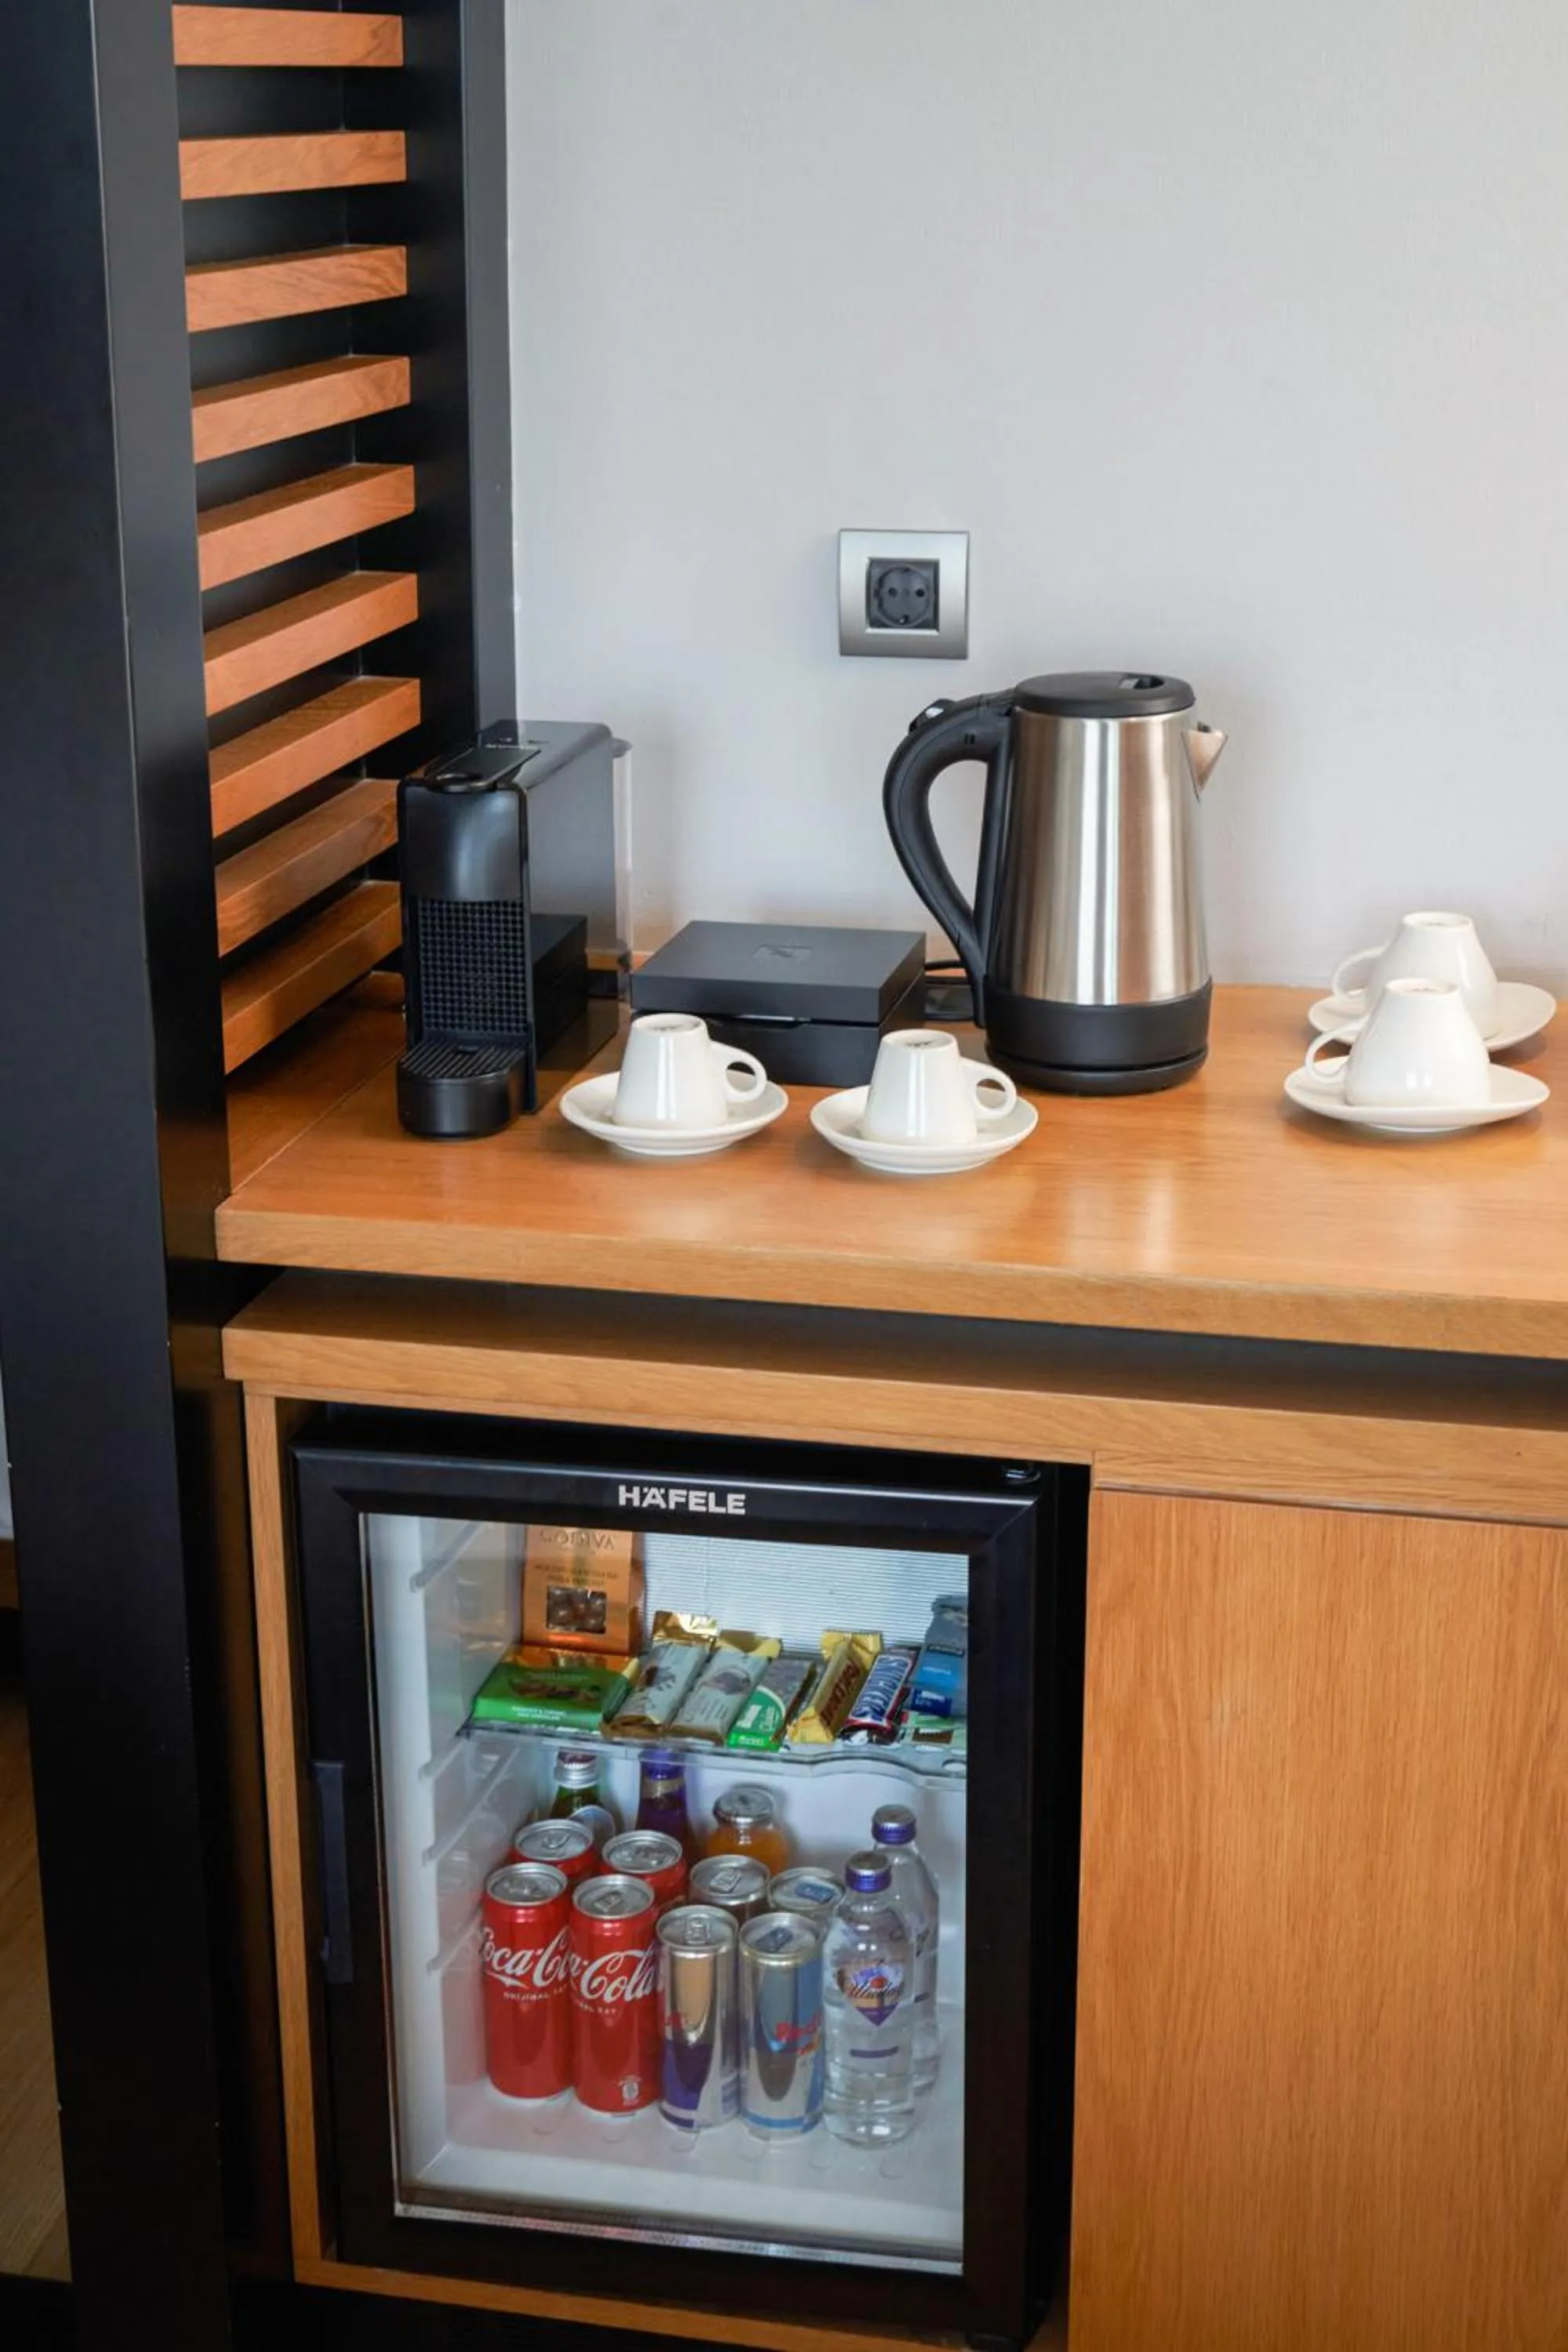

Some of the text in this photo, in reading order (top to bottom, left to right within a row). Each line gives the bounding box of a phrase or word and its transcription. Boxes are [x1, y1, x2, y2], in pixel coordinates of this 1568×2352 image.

[619, 1485, 746, 1515] HÄFELE
[481, 1925, 569, 1988] oca-Col
[570, 1940, 654, 2004] a-Cola
